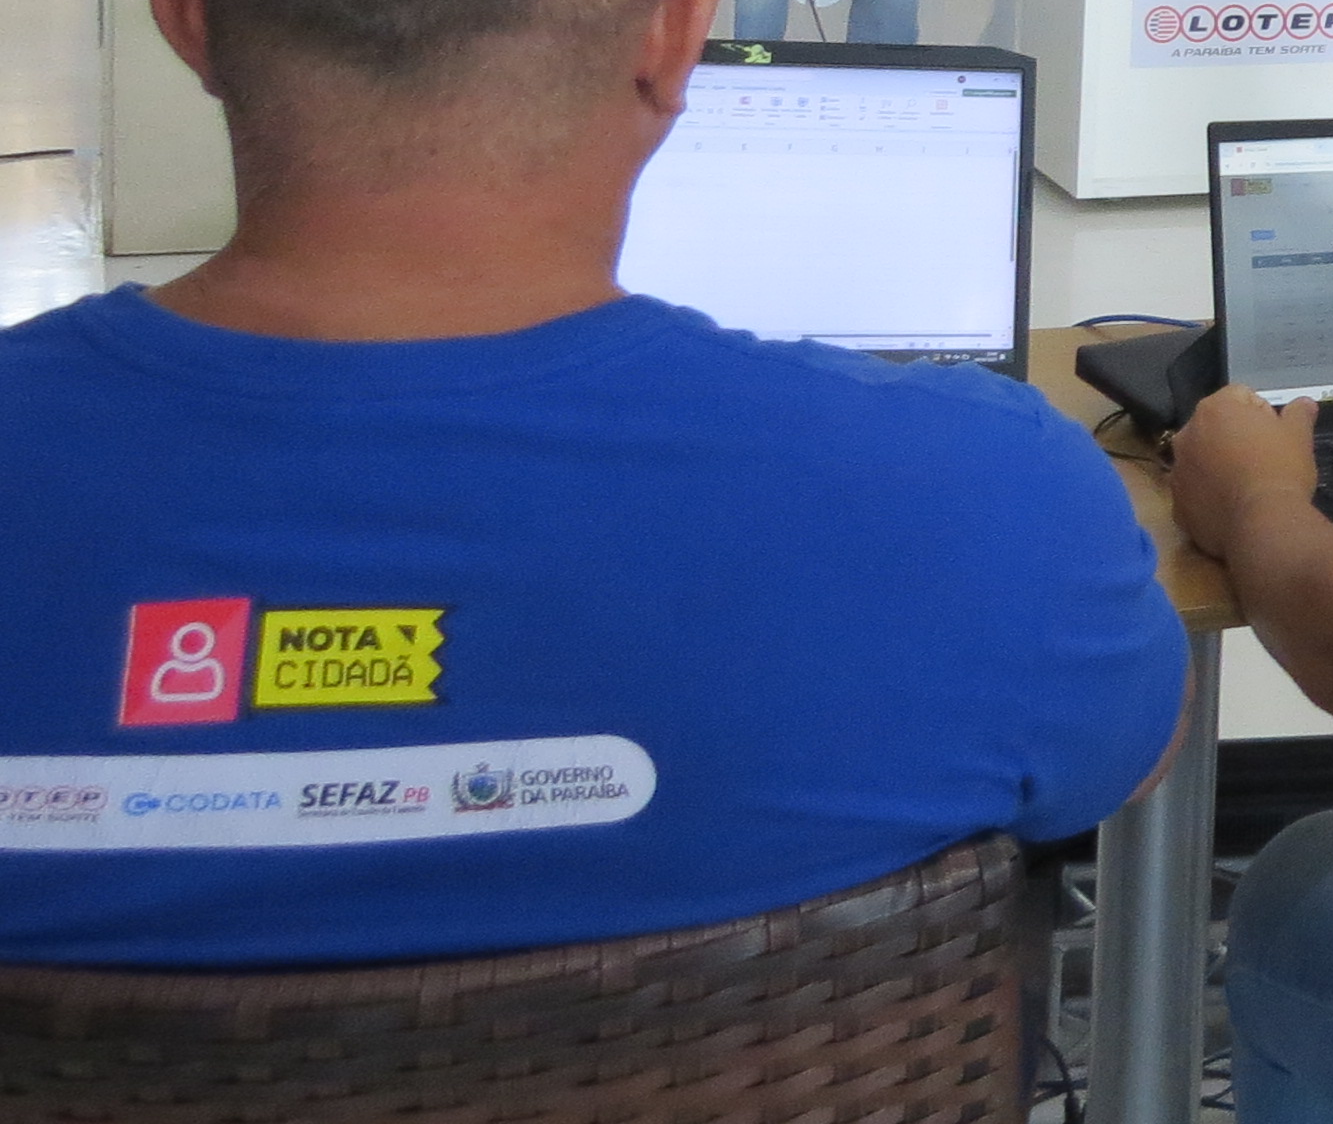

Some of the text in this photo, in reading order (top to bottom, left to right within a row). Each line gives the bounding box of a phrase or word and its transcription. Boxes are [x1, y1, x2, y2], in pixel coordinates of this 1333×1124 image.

[1170, 44, 1328, 58] A PARAÍBA TEM SORTE
[279, 625, 383, 653] NOTA
[274, 654, 415, 690] CIDADÃ
[519, 764, 614, 787] GOVERNO
[164, 790, 282, 813] CODATA
[300, 779, 431, 809] SEFAZ PB
[520, 788, 549, 806] DA
